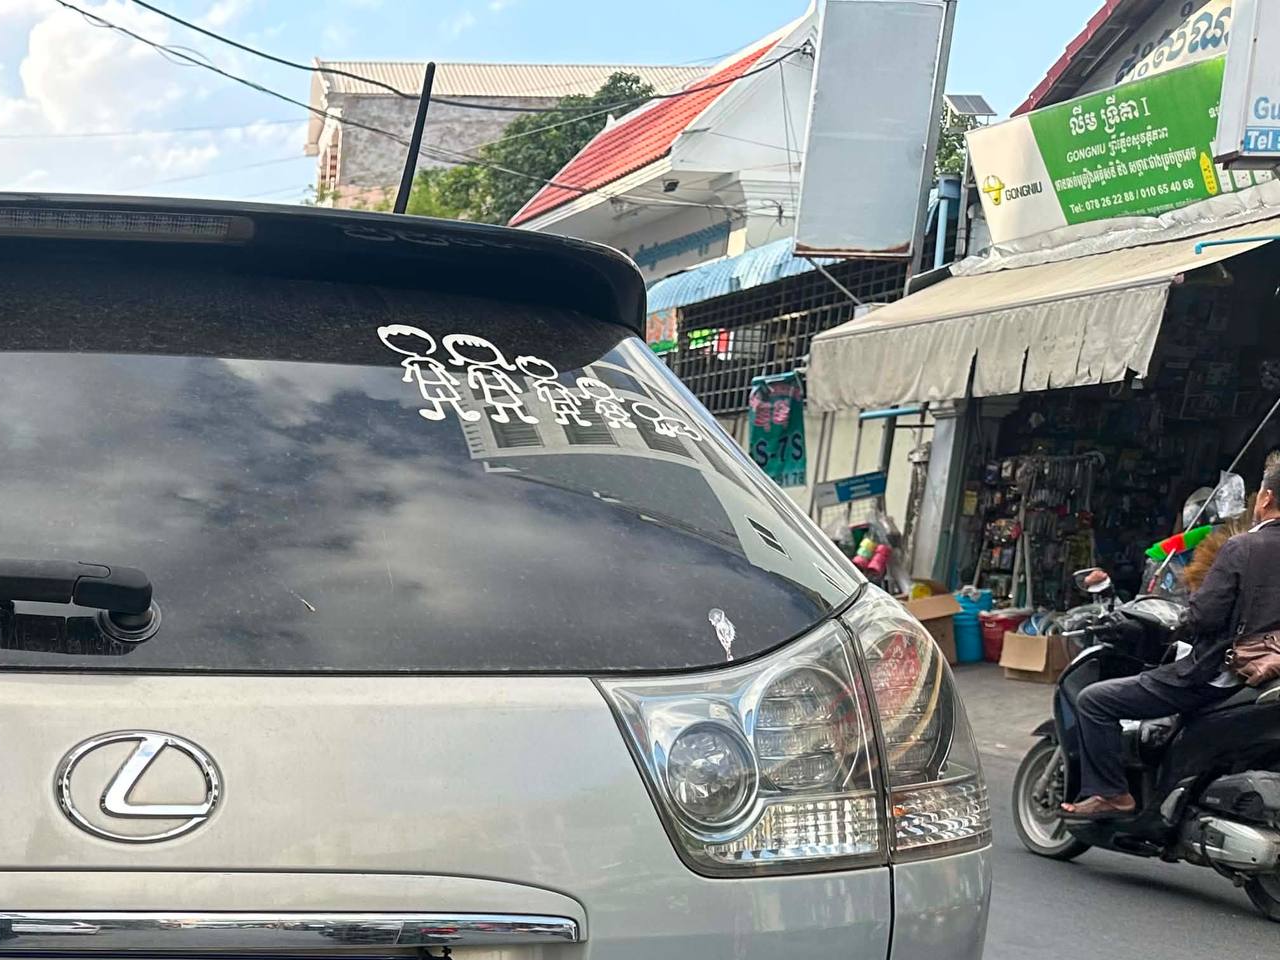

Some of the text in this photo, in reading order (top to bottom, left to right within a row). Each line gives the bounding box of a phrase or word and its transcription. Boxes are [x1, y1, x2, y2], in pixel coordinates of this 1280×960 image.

[1066, 143, 1107, 163] GONGNIU
[1069, 203, 1085, 214] Tel:
[1085, 199, 1100, 211] 078
[1100, 196, 1112, 208] 26
[1112, 193, 1123, 204] 22
[1123, 190, 1135, 201] 88
[1140, 186, 1156, 198] 010
[1157, 183, 1169, 195] 65
[1170, 181, 1181, 192] 40
[1182, 178, 1195, 189] 68
